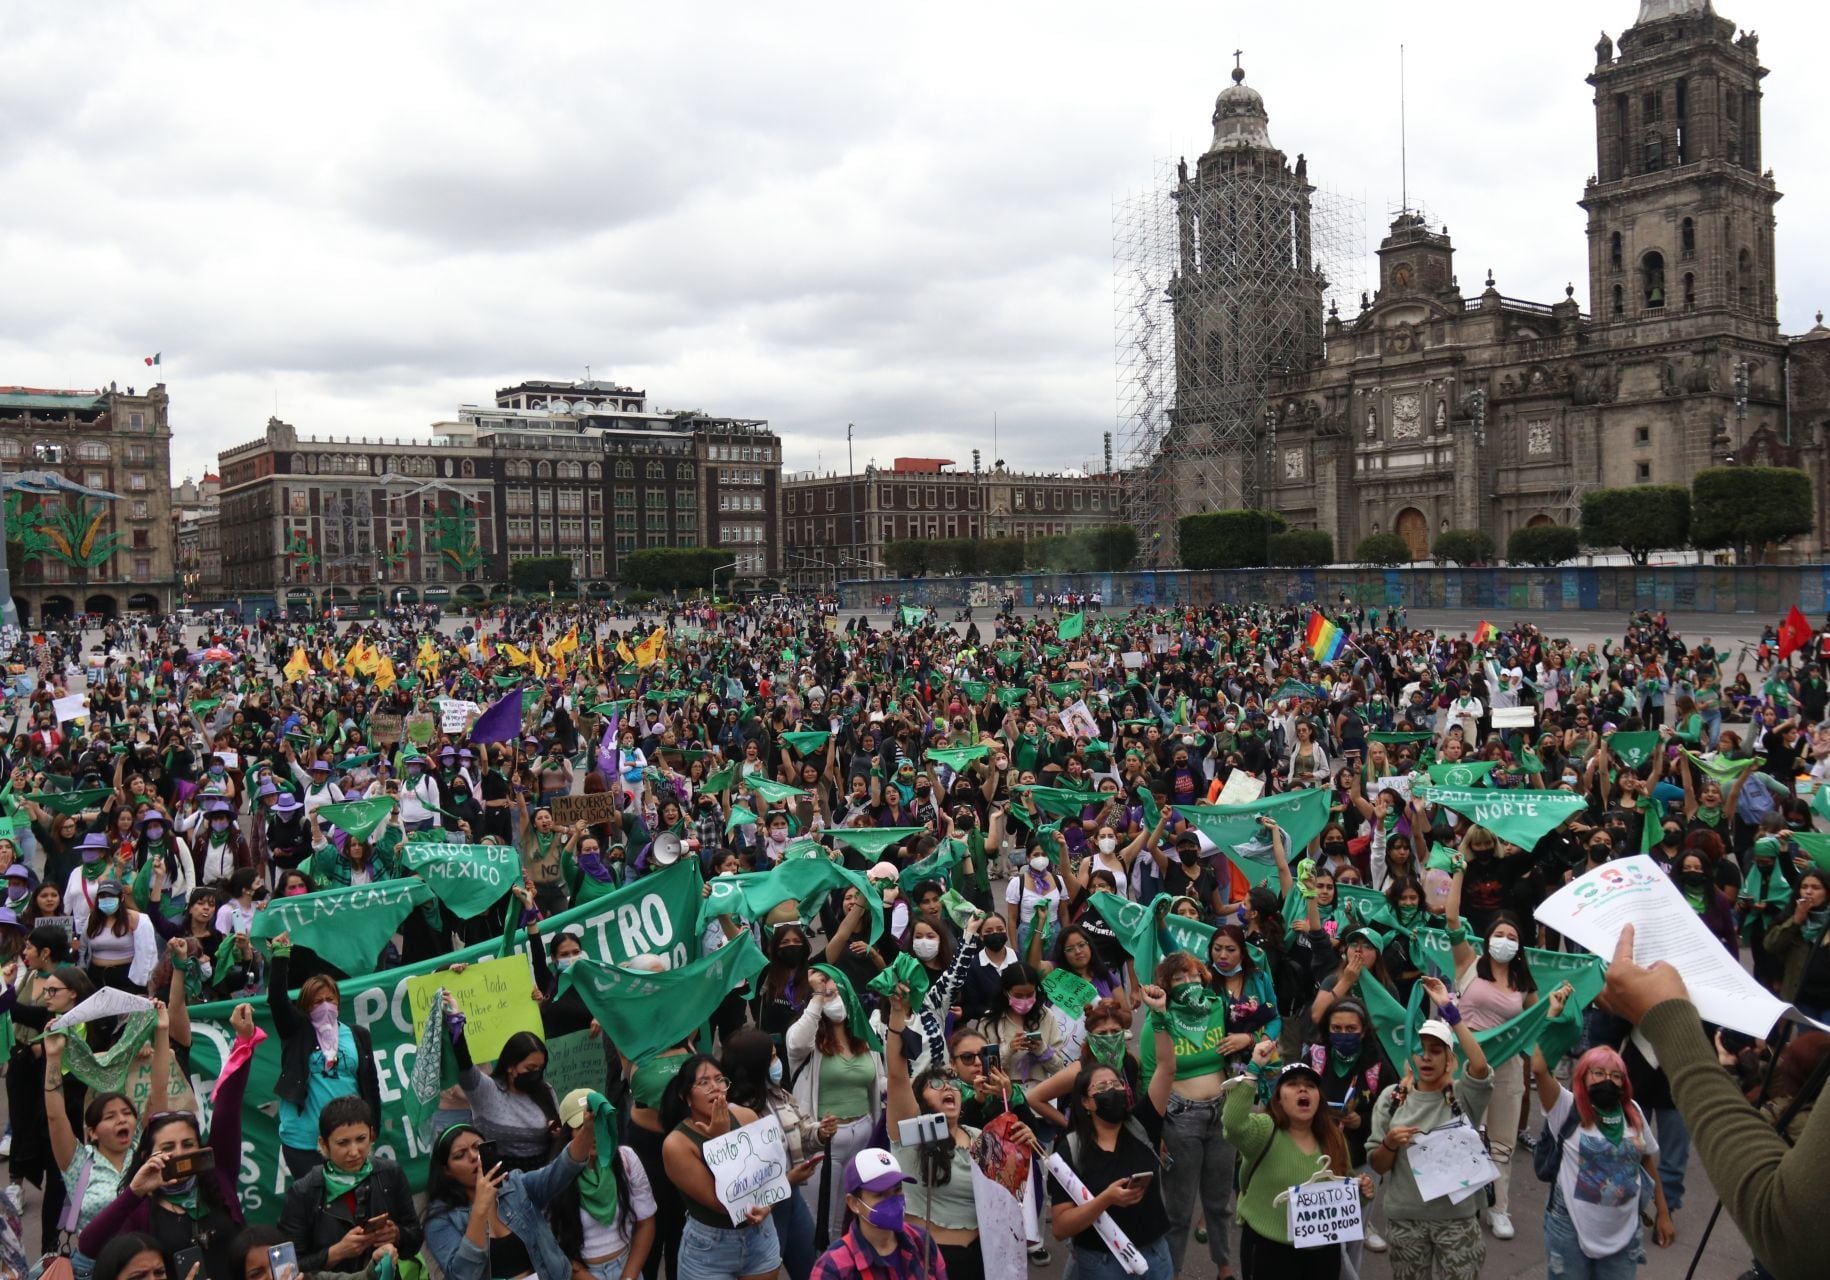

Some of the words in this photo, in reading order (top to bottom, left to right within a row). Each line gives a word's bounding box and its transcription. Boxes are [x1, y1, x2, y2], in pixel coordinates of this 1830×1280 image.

[574, 795, 613, 810] CUERPO
[1475, 803, 1538, 822] NORTE
[404, 843, 473, 864] ESTADO
[487, 845, 511, 864] DE
[1296, 1188, 1343, 1207] ABORTO
[1296, 1206, 1338, 1223] ABORTO
[1340, 1203, 1356, 1218] NO
[1294, 1223, 1316, 1238] ESO
[1317, 1222, 1330, 1234] LO
[1331, 1217, 1360, 1232] DECIDO
[1323, 1232, 1339, 1242] YO
